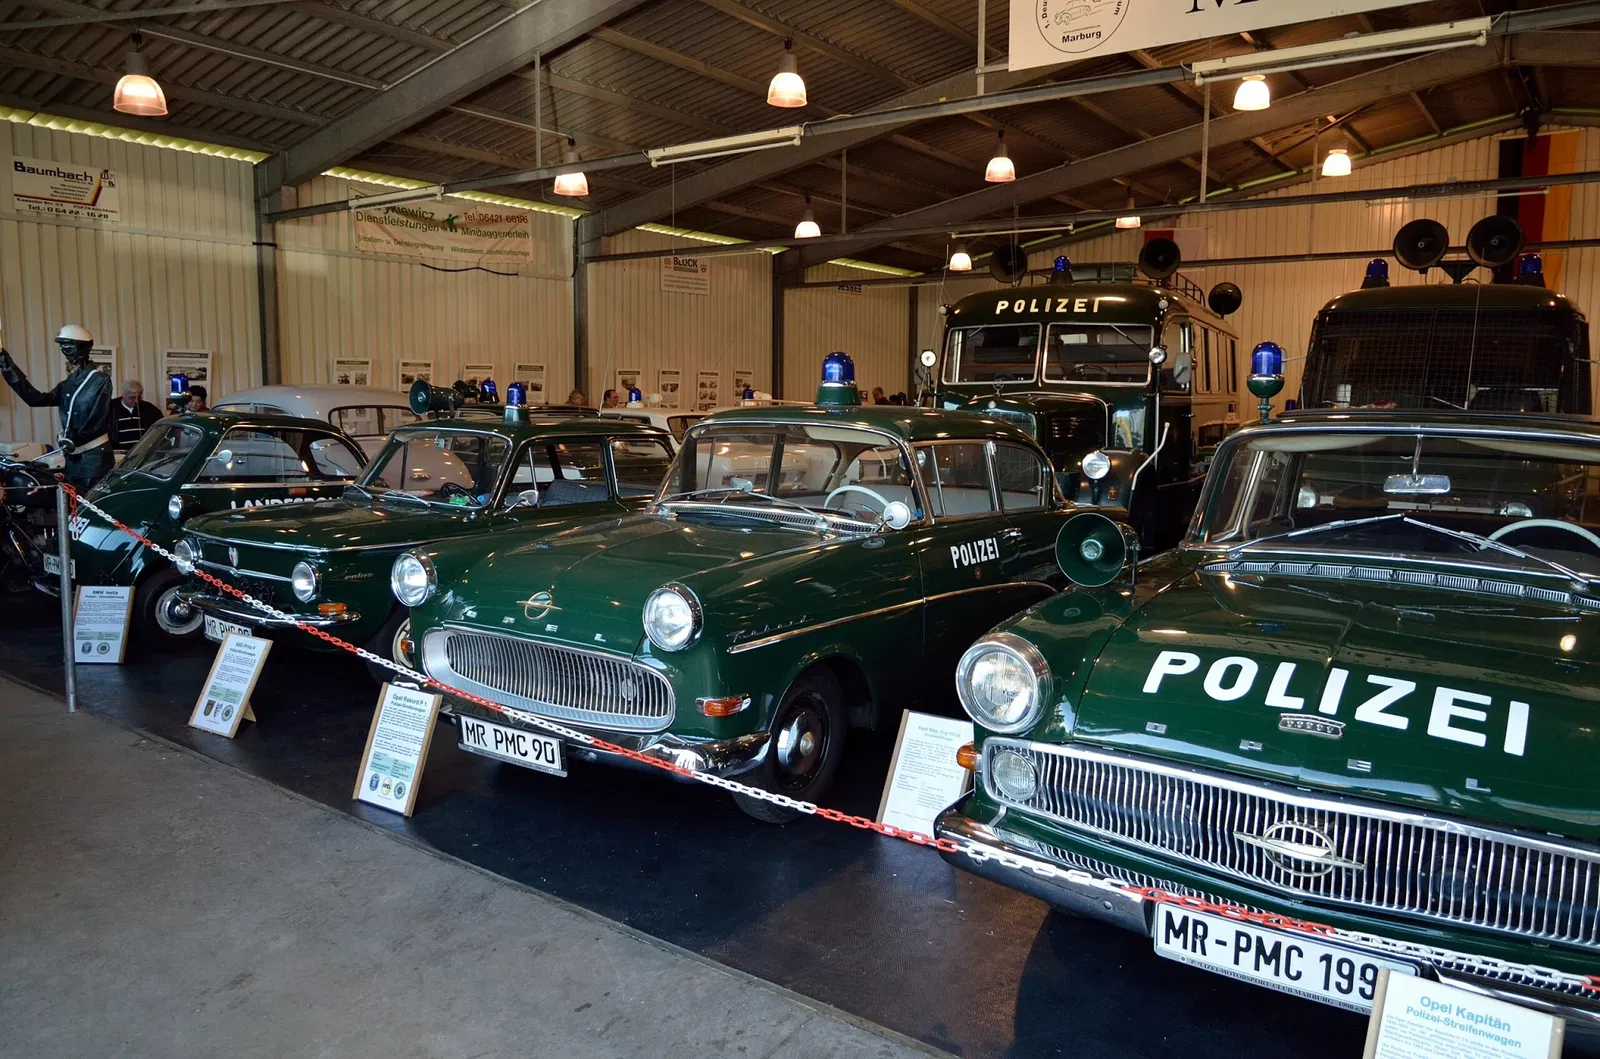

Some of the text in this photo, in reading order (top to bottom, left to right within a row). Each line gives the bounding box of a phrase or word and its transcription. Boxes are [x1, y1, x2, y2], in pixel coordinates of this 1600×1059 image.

[1061, 30, 1102, 44] Marburg
[13, 160, 93, 182] Baumbach
[356, 211, 440, 232] Dienstleistungen
[463, 212, 477, 222] Tel.
[479, 213, 503, 223] 06421
[461, 226, 530, 240] Minibaggerverleih
[673, 256, 698, 268] BLOCK
[995, 297, 1100, 314] POLIZEI
[950, 537, 1000, 569] POLIZEI
[1142, 650, 1530, 756] POLIZEI
[465, 719, 488, 747] MR
[493, 728, 529, 757] PMC
[533, 737, 556, 765] 90
[1164, 910, 1379, 1001] MR-PMC 199
[1294, 986, 1335, 1005] MARBURG
[1420, 995, 1512, 1032] Opel Kapitän
[1406, 1006, 1522, 1049] Polizei-Streifenwagen
